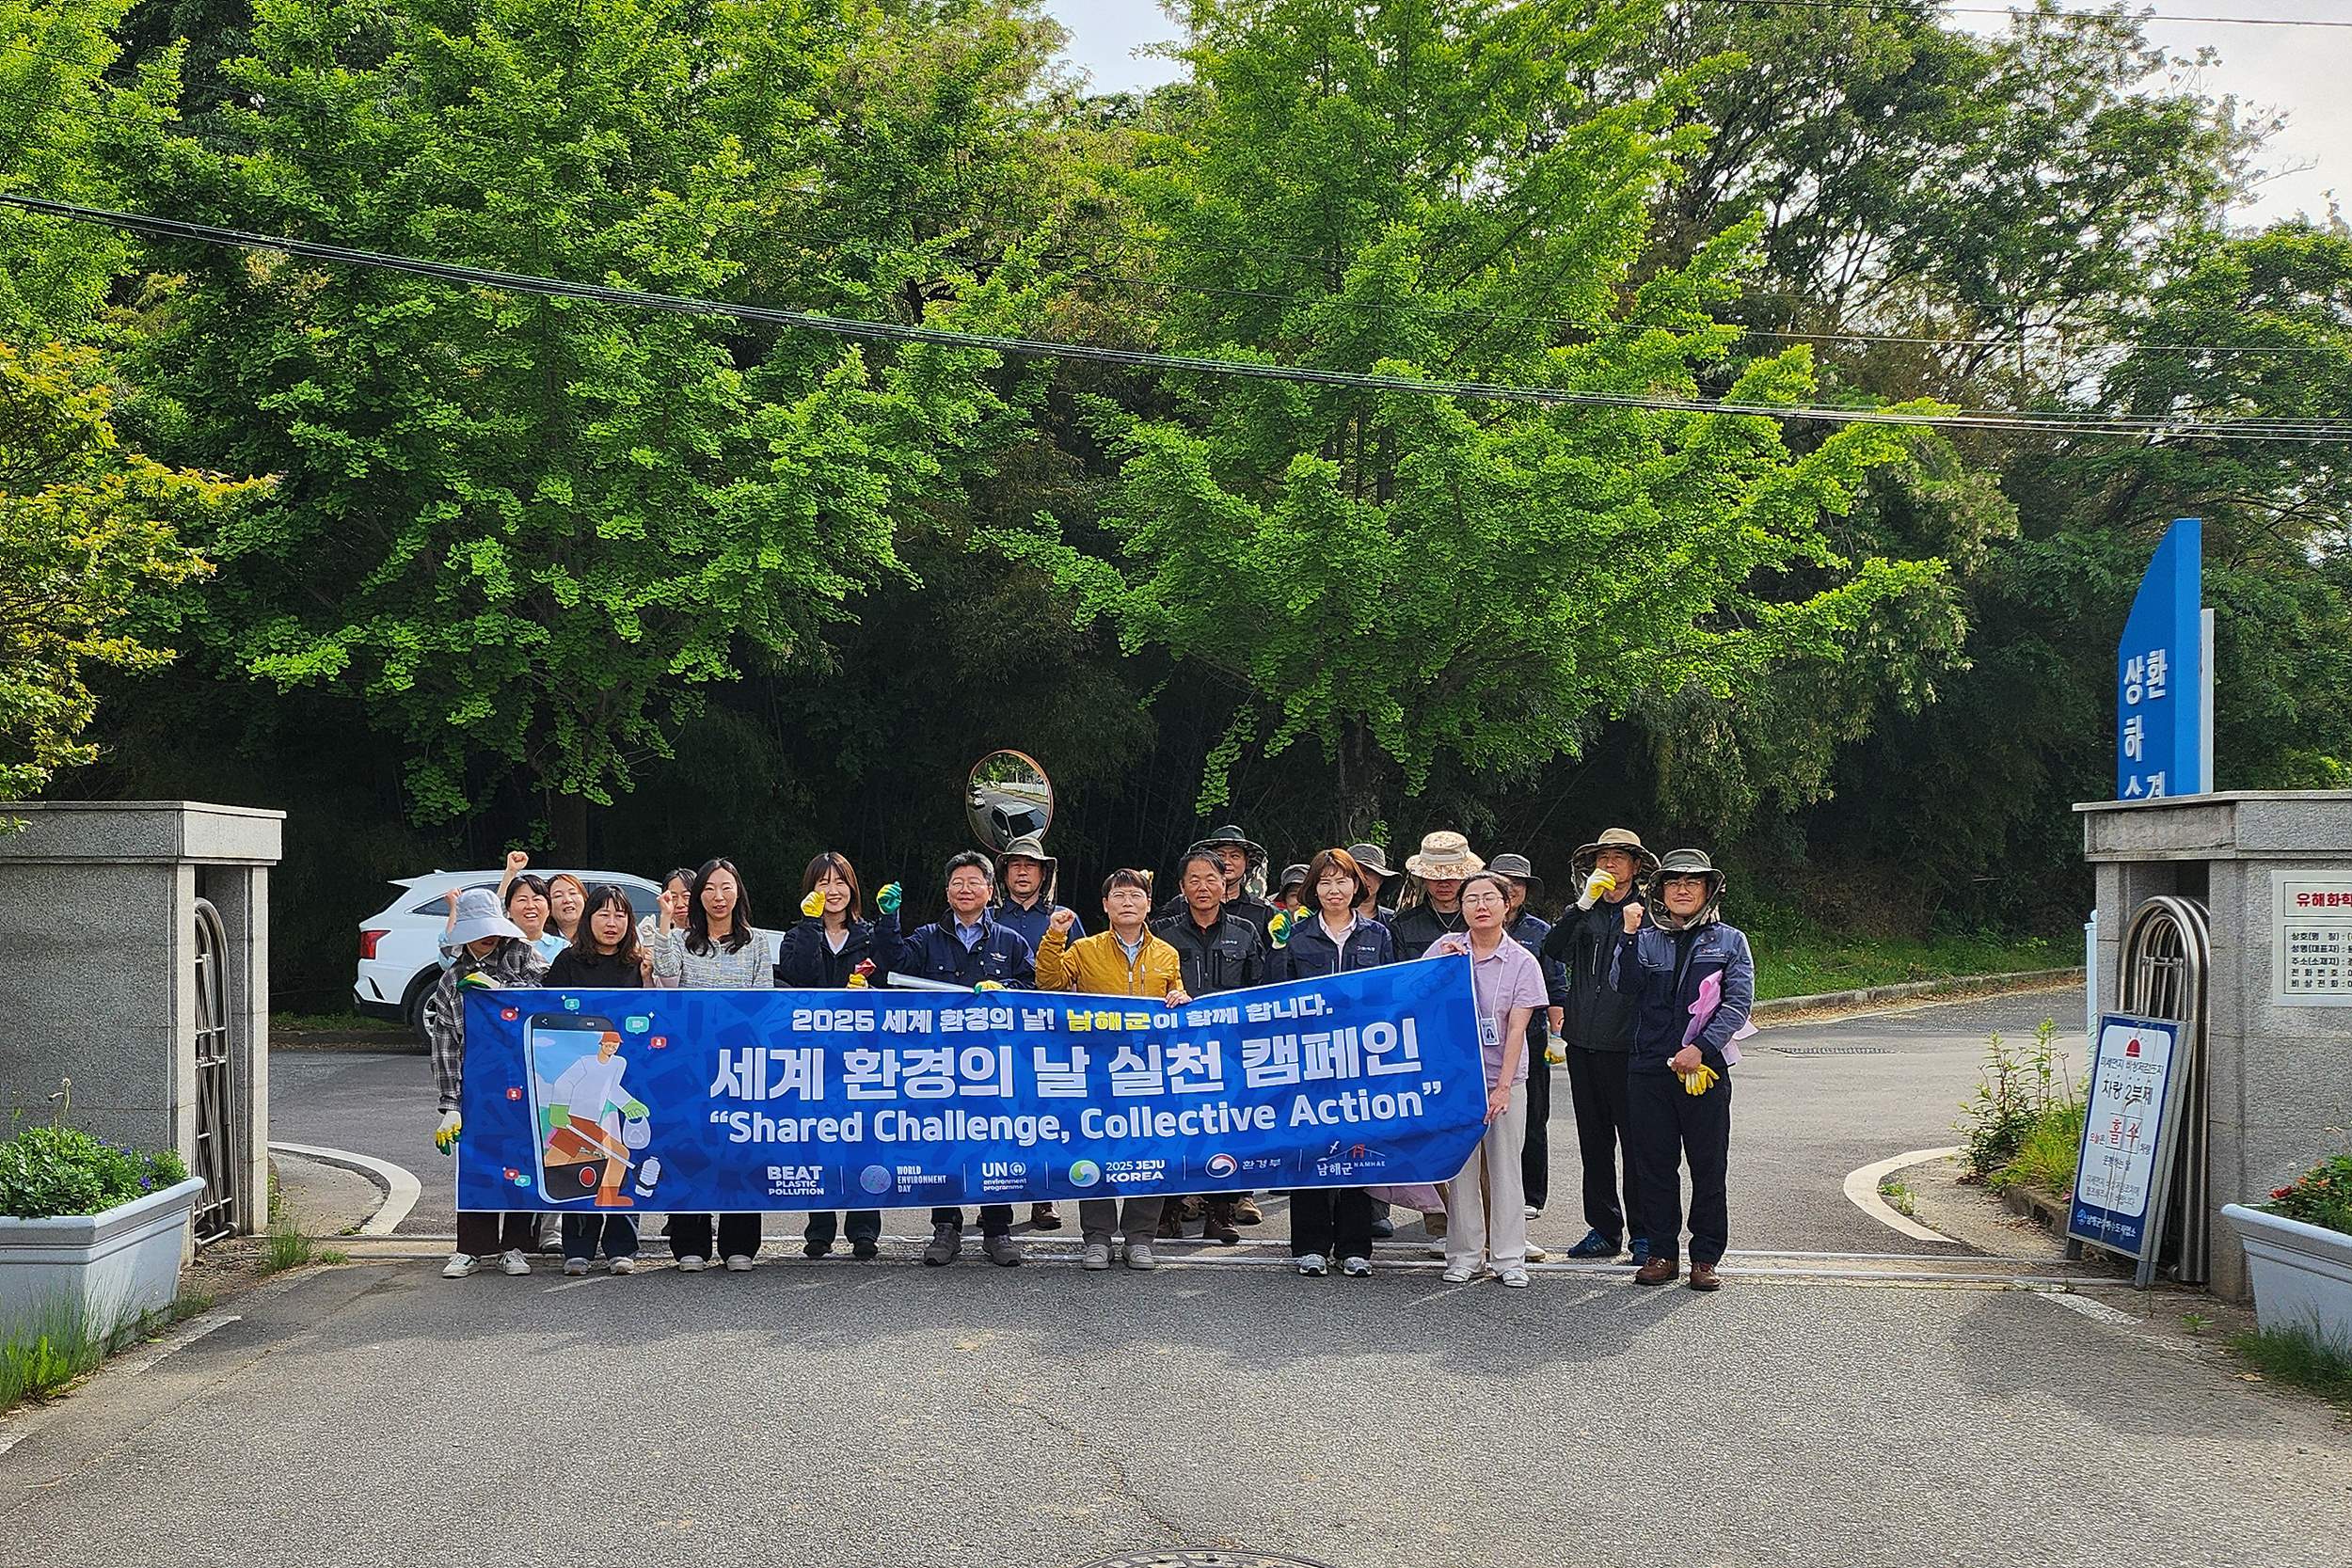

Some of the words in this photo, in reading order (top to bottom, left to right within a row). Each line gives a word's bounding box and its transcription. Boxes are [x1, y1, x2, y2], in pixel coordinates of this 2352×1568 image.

[792, 1009, 874, 1031] 2025
[882, 1010, 932, 1033] 세계
[940, 1007, 1014, 1032] 환경의
[1022, 1008, 1055, 1030] 날!
[1067, 1008, 1178, 1032] 남해군이
[1186, 1006, 1238, 1027] 함께
[1245, 993, 1333, 1022] 합니다.
[709, 1047, 824, 1101] 세계
[843, 1045, 1014, 1100] 환경의
[1033, 1045, 1090, 1098] 날
[1108, 1040, 1224, 1098] 실천
[1242, 1017, 1422, 1089] 캠페인
[2102, 1079, 2123, 1100] 차량
[710, 1110, 863, 1144] “Shared
[874, 1109, 1070, 1147] Challenge,
[1081, 1101, 1277, 1139] Collective
[1289, 1081, 1441, 1127] Action”
[897, 1165, 921, 1175] WORLD
[981, 1162, 1008, 1177] UN
[1105, 1162, 1134, 1171] 2025
[1135, 1159, 1166, 1169] JEJU
[1242, 1158, 1282, 1170] 환경부
[1316, 1162, 1353, 1177] 남해군
[767, 1165, 823, 1180] BEAT
[1105, 1171, 1165, 1183] KOREA
[775, 1180, 817, 1188] PLASTIC
[897, 1175, 946, 1185] ENVIRONMENT
[769, 1187, 824, 1196] POLLUTION
[898, 1184, 912, 1194] DAY
